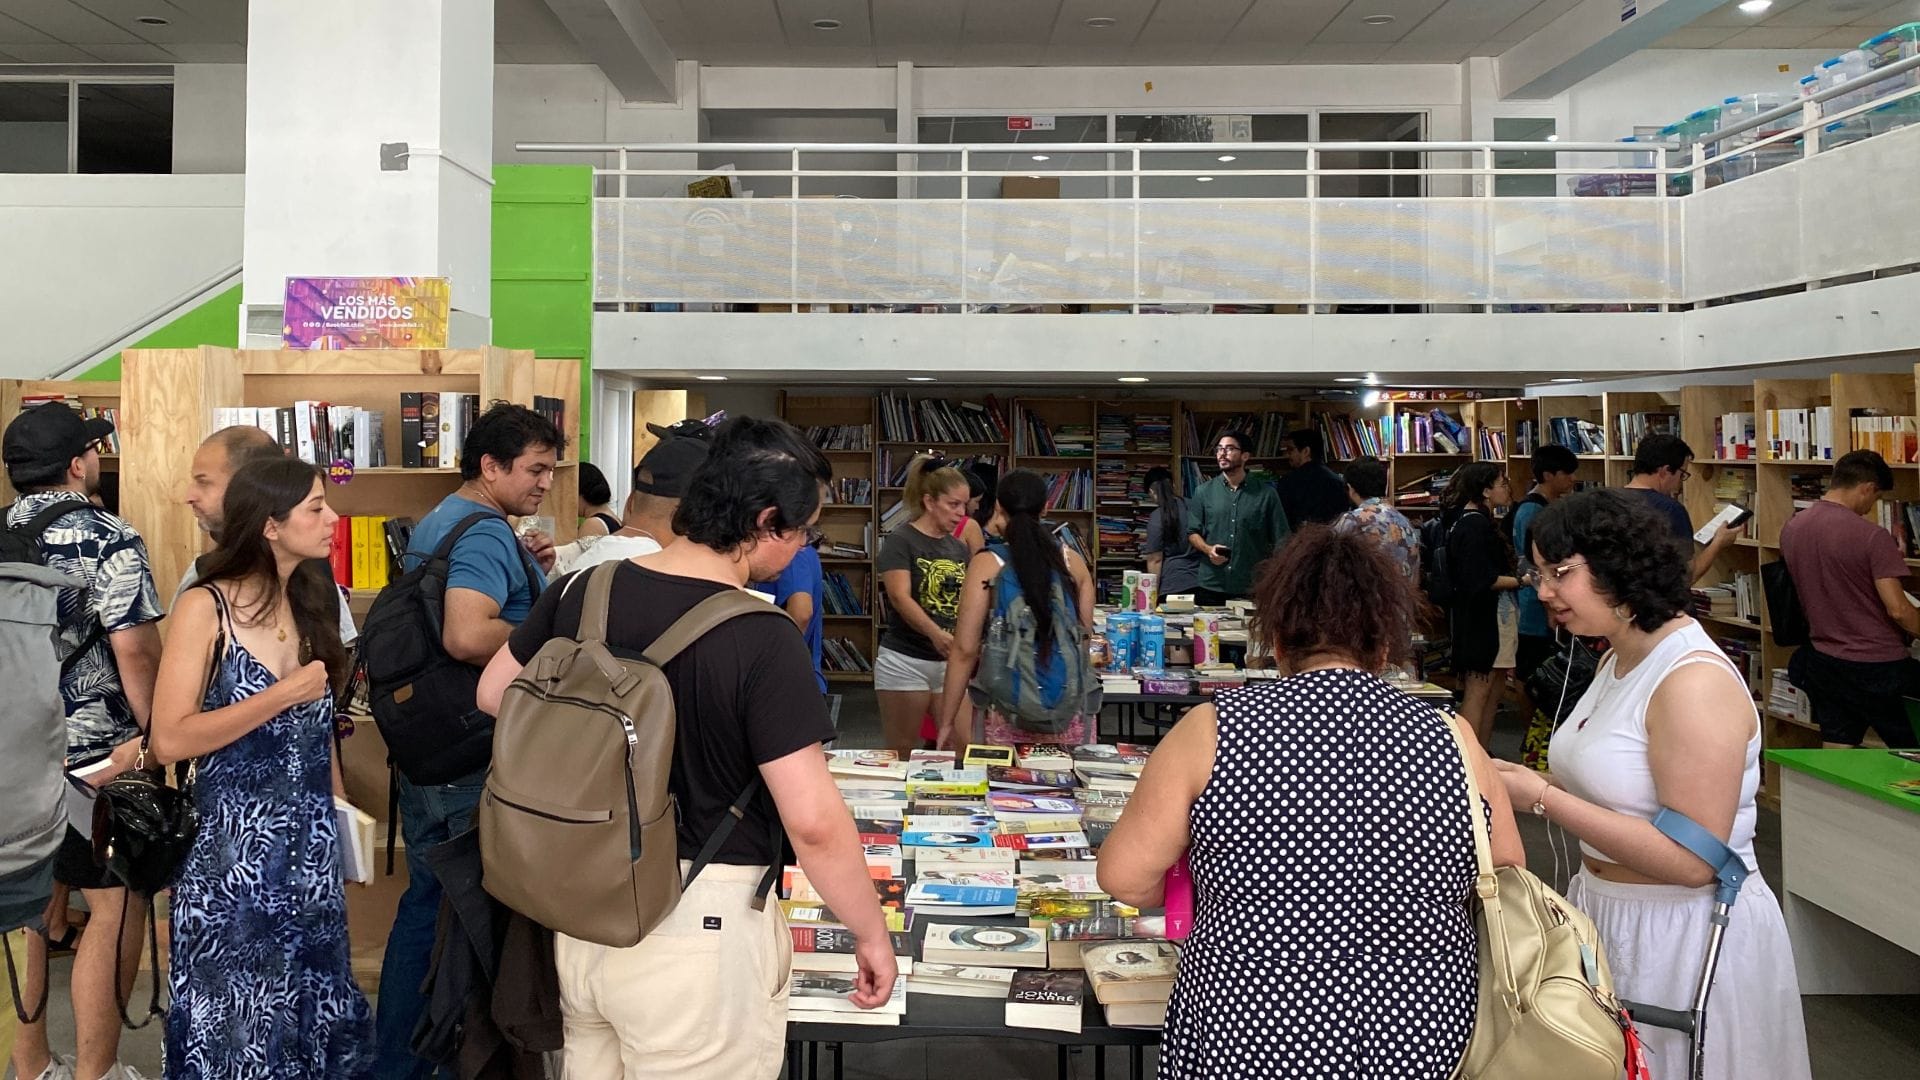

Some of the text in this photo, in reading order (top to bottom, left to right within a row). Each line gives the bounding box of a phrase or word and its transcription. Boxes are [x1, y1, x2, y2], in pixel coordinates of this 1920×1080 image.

[338, 293, 396, 306] LOS MÁS
[321, 306, 413, 320] VENDIDOS
[330, 466, 352, 476] 50%
